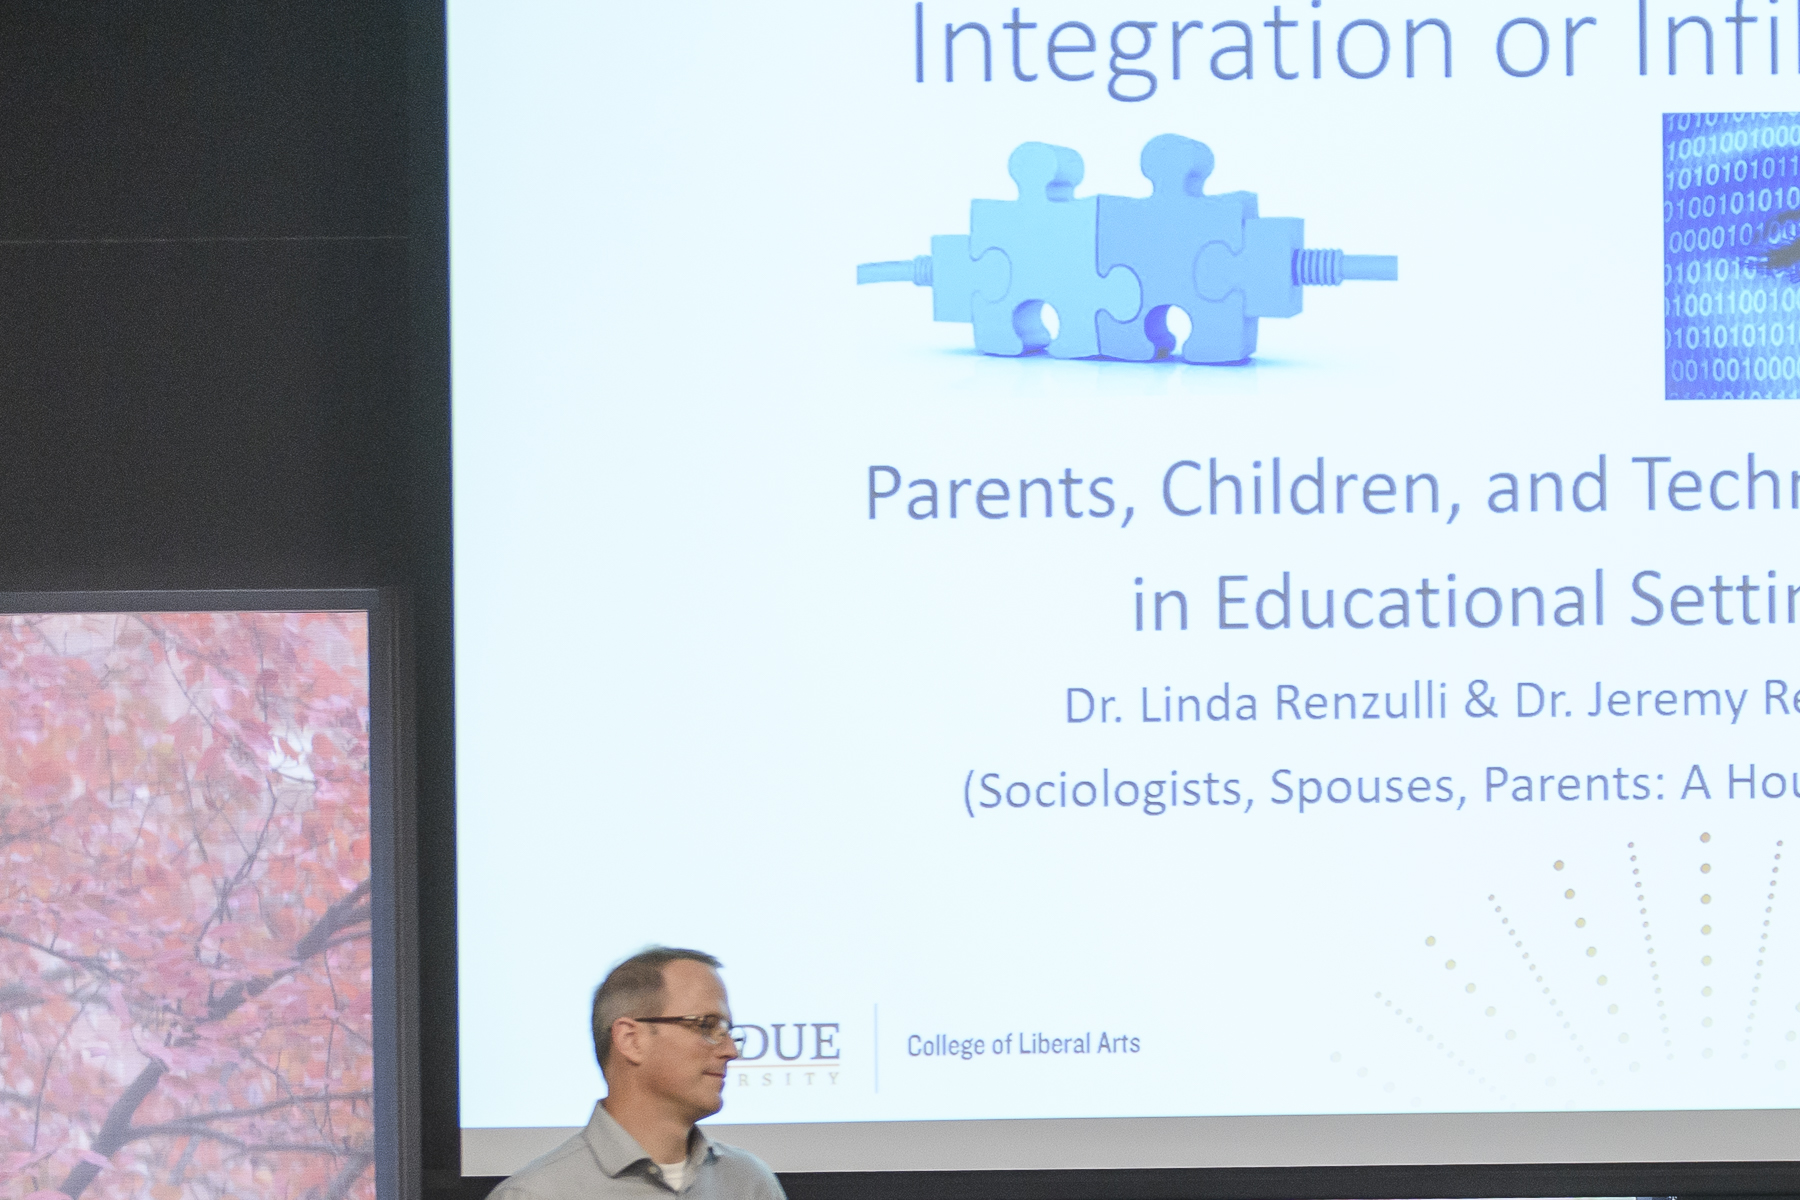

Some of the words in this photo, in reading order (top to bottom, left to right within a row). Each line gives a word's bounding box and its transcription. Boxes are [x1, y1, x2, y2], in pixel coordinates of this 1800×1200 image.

[915, 0, 1454, 103] Integration
[1496, 17, 1599, 80] or
[868, 464, 1136, 530] Parents,
[1163, 457, 1462, 526] Children,
[1488, 454, 1608, 515] and
[1135, 577, 1189, 633] in
[1219, 568, 1605, 632] Educational
[1067, 688, 1123, 725] Dr.
[1142, 682, 1258, 724] Linda
[1277, 680, 1448, 722] Renzulli
[1465, 680, 1500, 720] &
[1517, 682, 1573, 719] Dr.
[1588, 682, 1750, 726] Jeremy
[964, 768, 1255, 820] (Sociologists,
[1271, 769, 1468, 815] Spouses,
[1486, 767, 1665, 804] Parents:
[1681, 764, 1713, 801] A
[736, 1022, 842, 1062] DUE
[907, 1034, 986, 1062] College
[992, 1033, 1014, 1056] of
[1019, 1032, 1092, 1055] Liberal
[1097, 1032, 1142, 1055] Arts
[738, 1071, 841, 1088] RSITY
